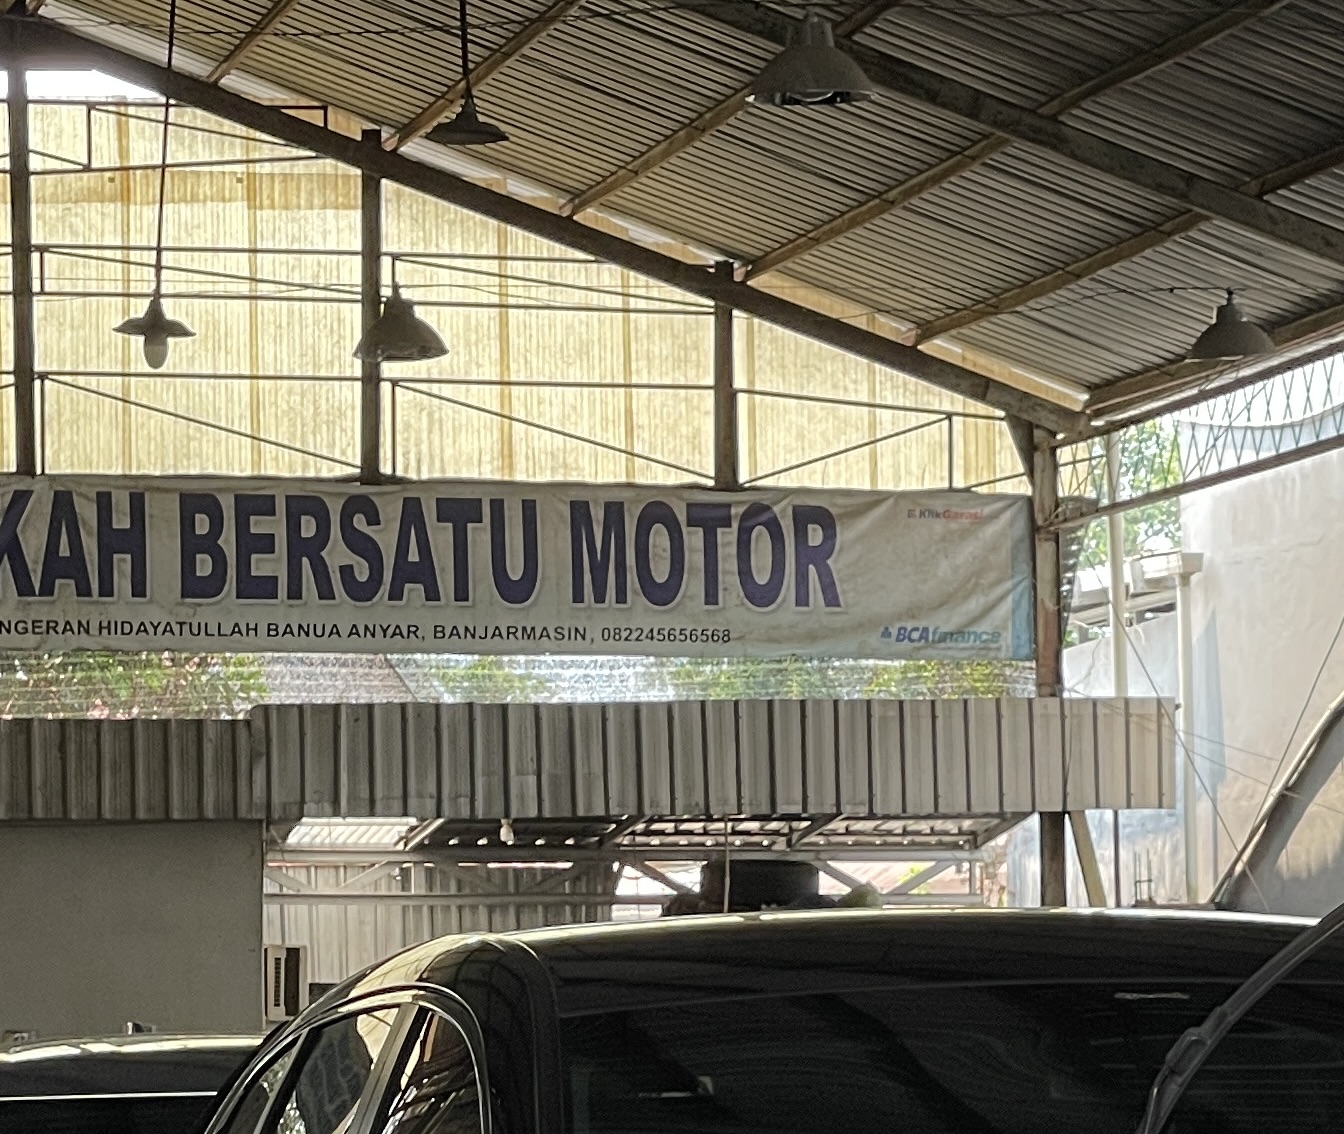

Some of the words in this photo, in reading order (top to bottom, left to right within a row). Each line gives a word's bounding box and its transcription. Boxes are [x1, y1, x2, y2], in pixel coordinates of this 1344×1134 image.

[179, 492, 539, 605] BERSATU
[570, 500, 842, 608] MOTOR
[98, 620, 258, 637] HIDAYATULLAH
[267, 623, 341, 638] BANUA
[347, 624, 425, 642] ANYAR,
[433, 625, 594, 644] BANJARMASIN,
[601, 627, 731, 643] 082245656568
